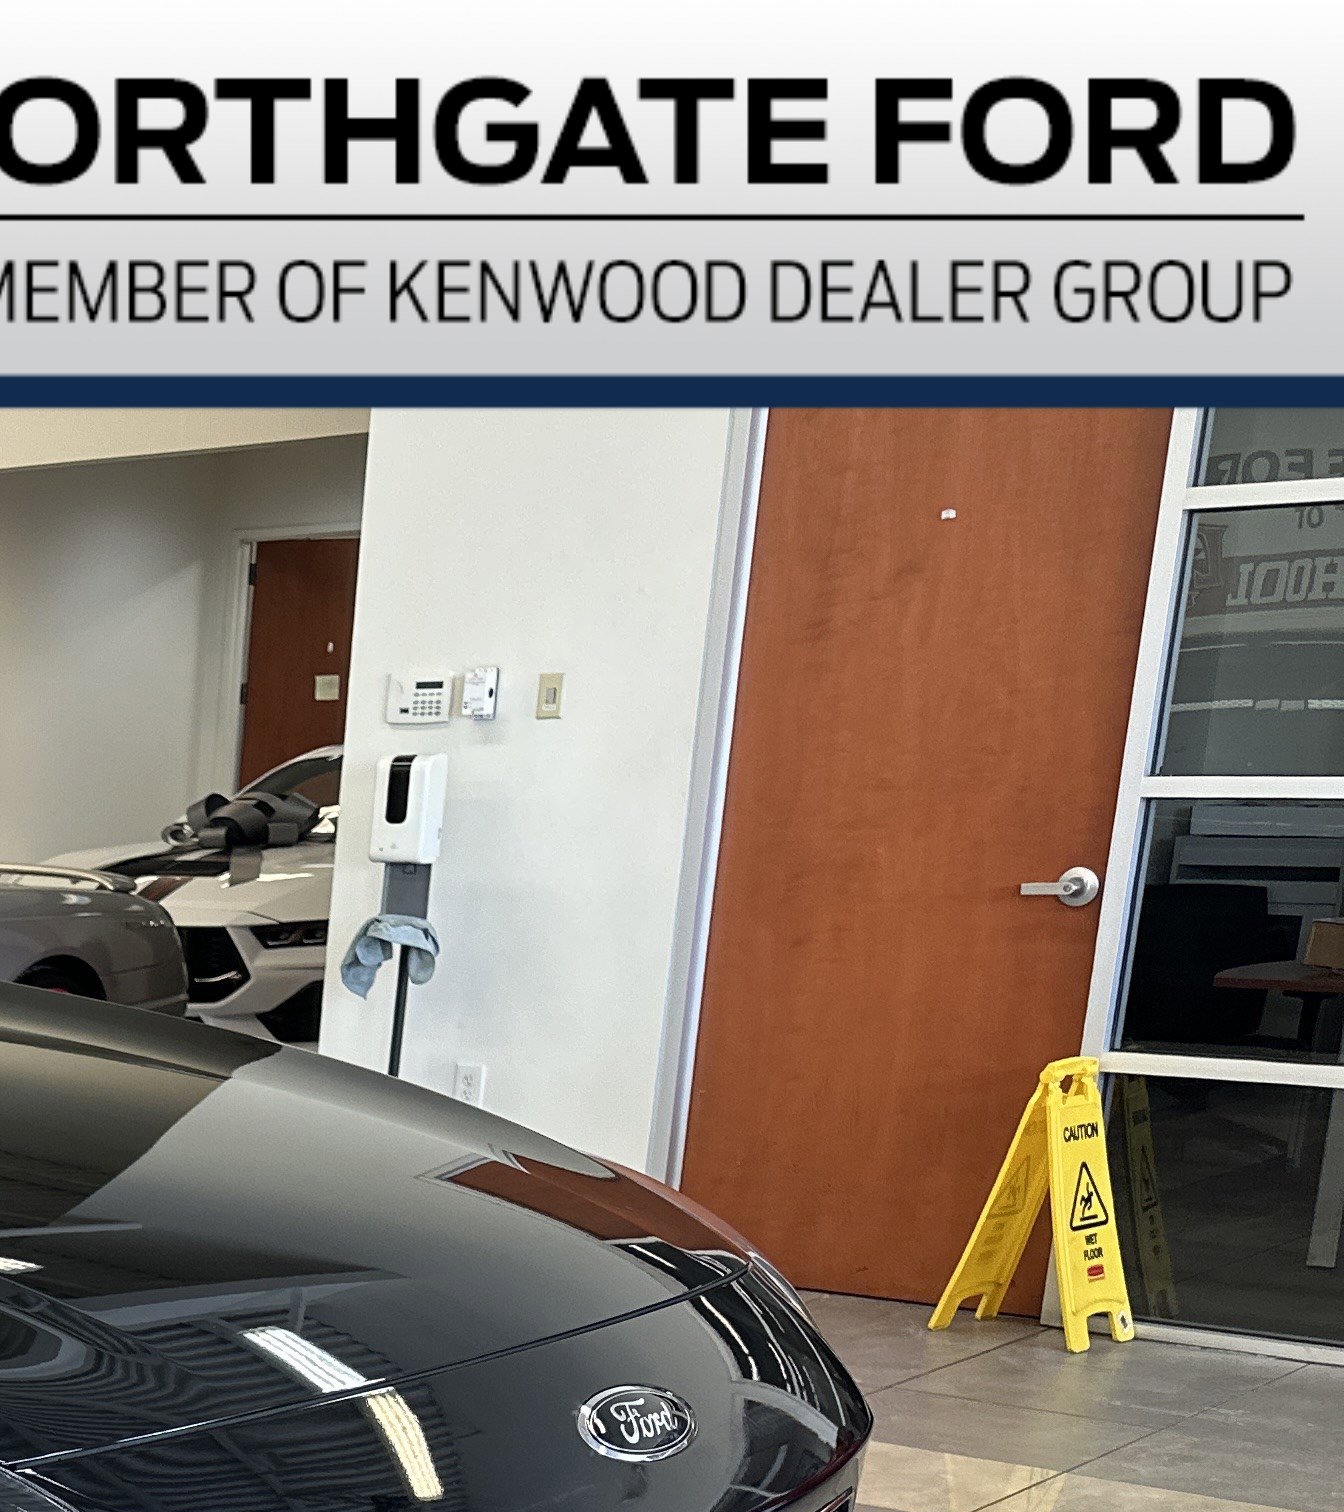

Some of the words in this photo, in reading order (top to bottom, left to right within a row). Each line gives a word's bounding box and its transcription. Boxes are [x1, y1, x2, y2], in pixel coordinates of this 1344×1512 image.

[1063, 1121, 1099, 1143] CAUTION
[1085, 1233, 1098, 1246] WET
[1083, 1247, 1104, 1262] FLOOR
[610, 1397, 678, 1444] Ford
